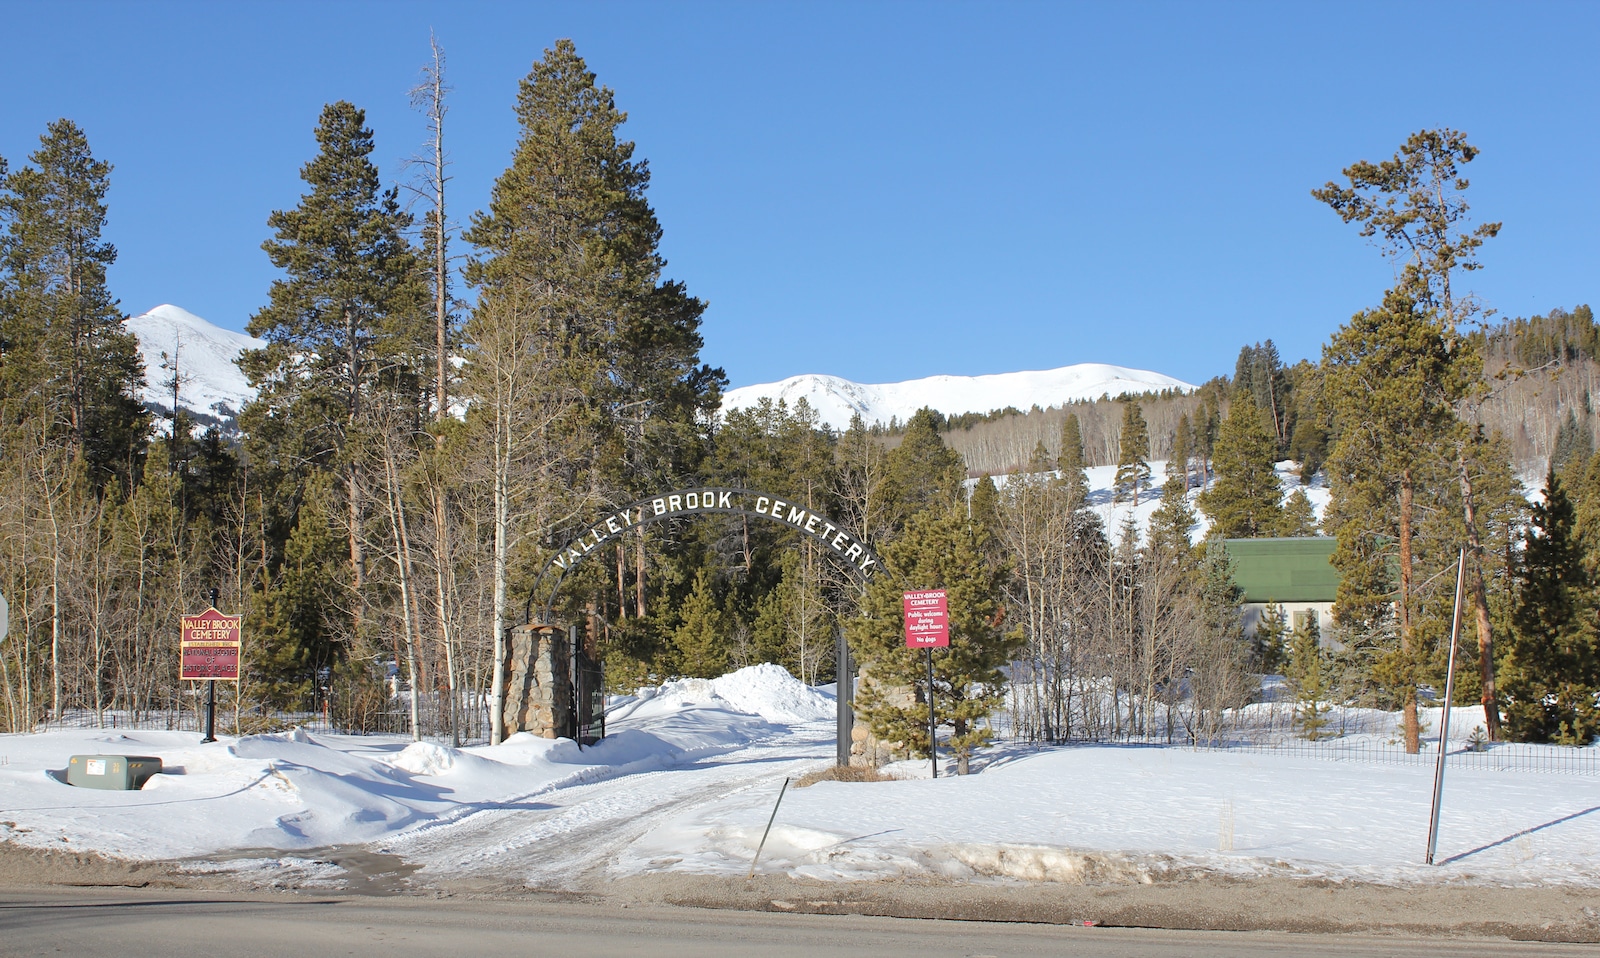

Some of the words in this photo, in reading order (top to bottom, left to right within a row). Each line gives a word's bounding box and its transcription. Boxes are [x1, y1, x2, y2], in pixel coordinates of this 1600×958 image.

[552, 508, 633, 570] VALLEY
[652, 491, 732, 516] BROOK
[755, 496, 877, 571] CEMETERY
[184, 620, 212, 630] VALLEY
[212, 620, 238, 630] BROOK
[909, 624, 929, 632] daylight
[190, 630, 232, 640] CEMETERY
[183, 648, 211, 656] NATIONAL
[213, 648, 237, 656] REGISTER
[205, 656, 216, 664] OF
[183, 664, 212, 672] HISTORIC
[213, 664, 238, 672] PLACES
